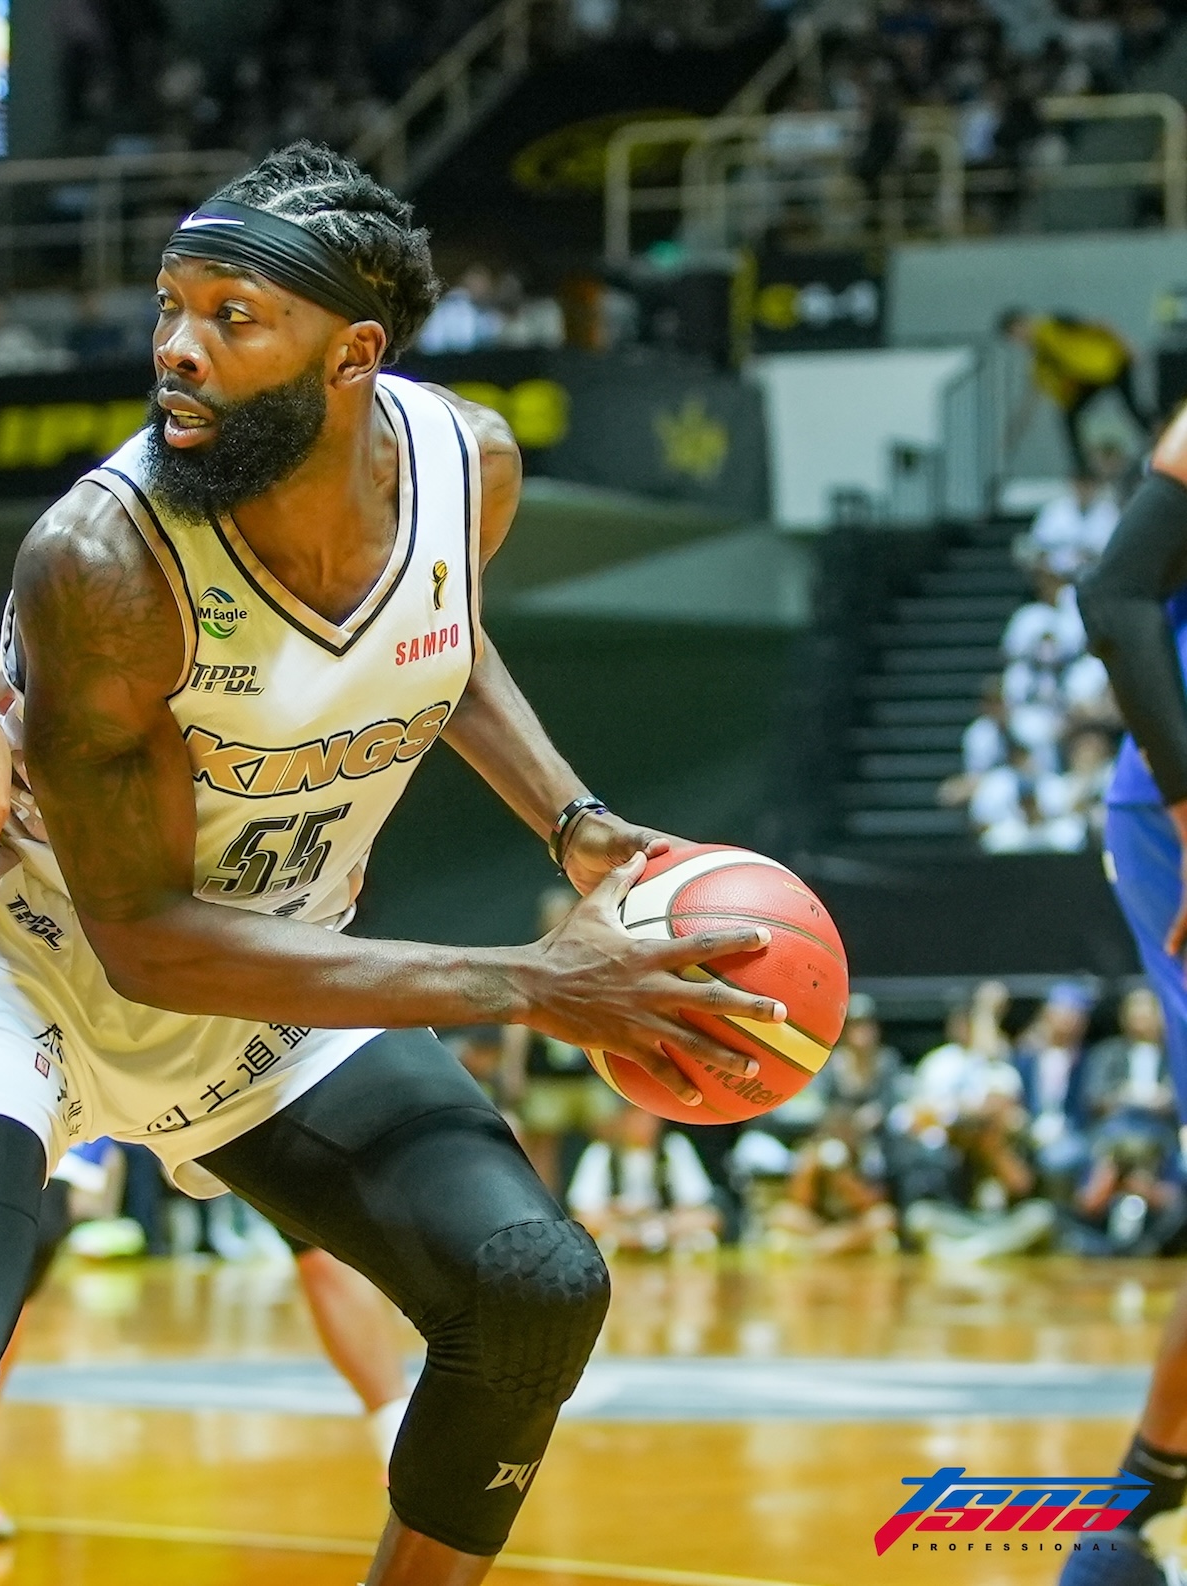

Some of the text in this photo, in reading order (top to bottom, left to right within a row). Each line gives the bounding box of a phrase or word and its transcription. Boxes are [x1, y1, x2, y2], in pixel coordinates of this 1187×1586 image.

[189, 661, 265, 696] TPBL
[395, 623, 459, 666] SAMPO
[183, 701, 451, 799] KINGS
[200, 802, 353, 899] 55
